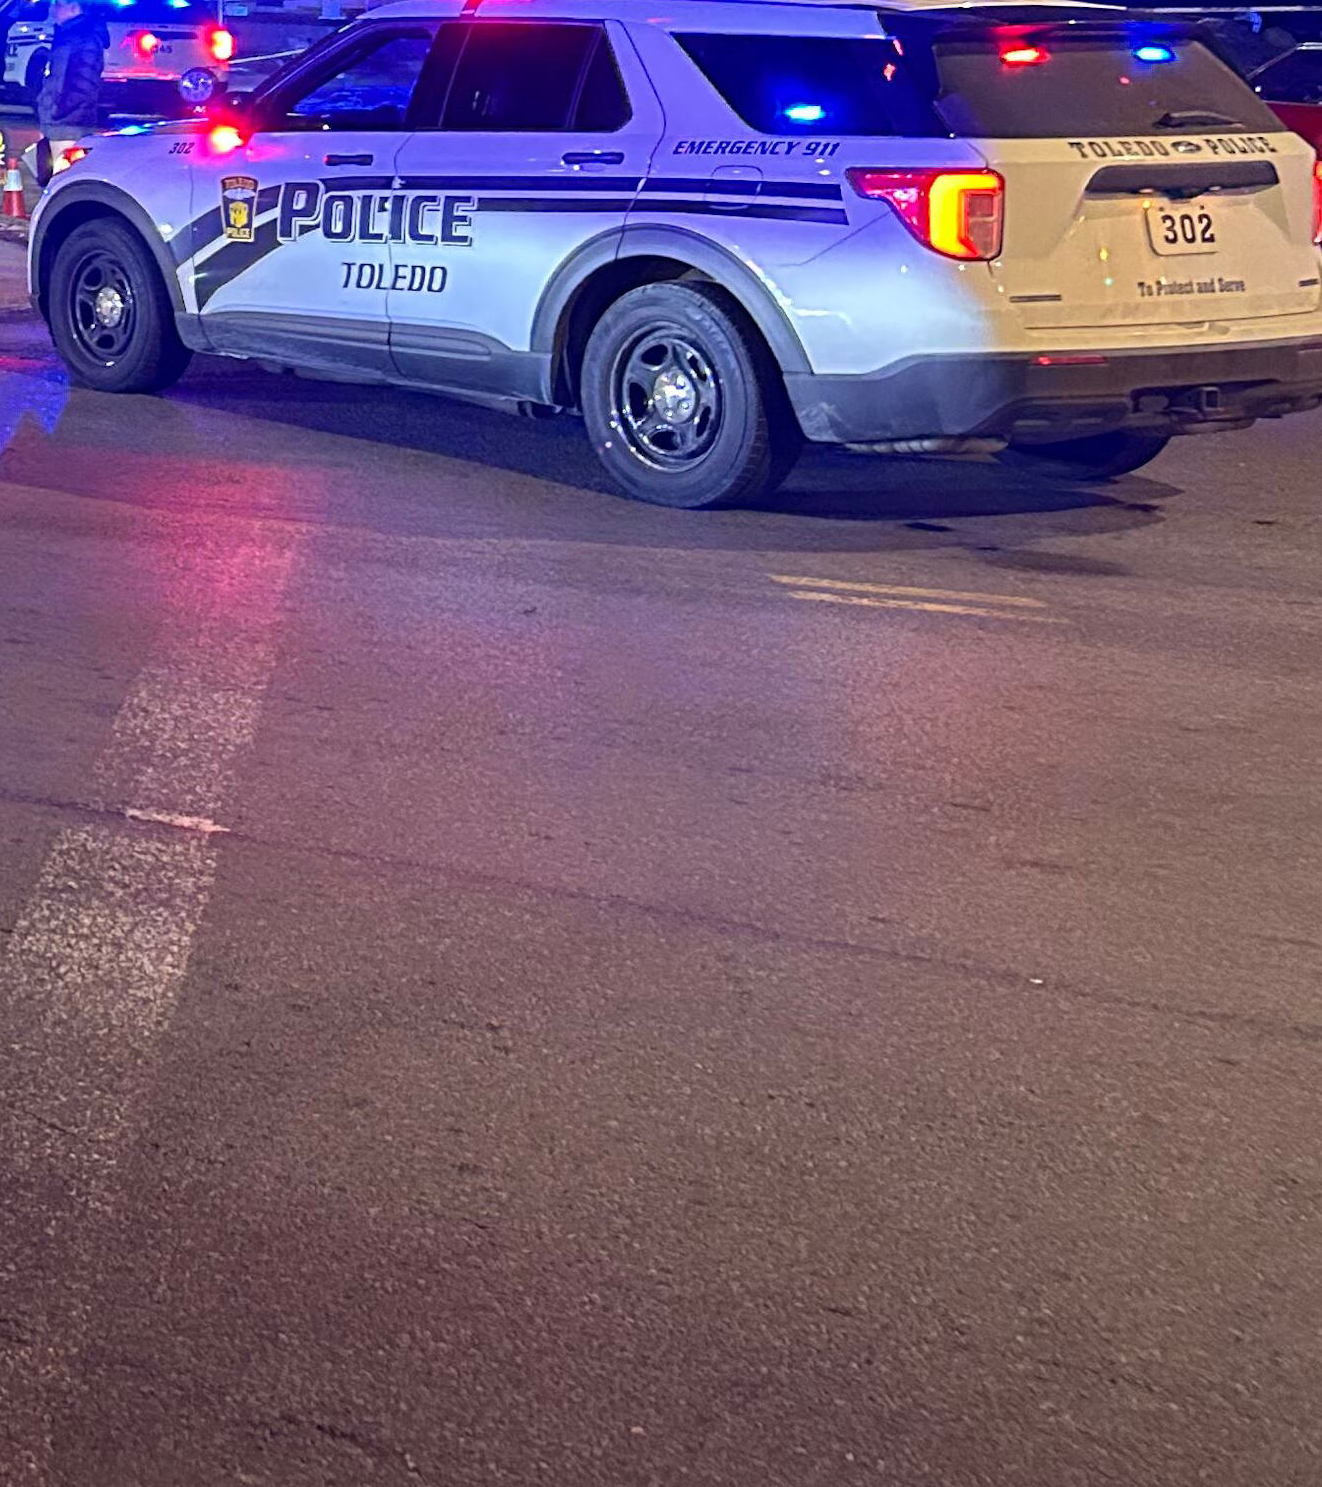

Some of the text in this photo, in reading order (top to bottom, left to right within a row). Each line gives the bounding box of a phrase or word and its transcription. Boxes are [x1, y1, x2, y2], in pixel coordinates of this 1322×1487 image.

[168, 142, 195, 154] 302
[672, 140, 840, 156] EMERGENCY 911
[1068, 136, 1277, 158] TOLEDO POLICE
[278, 181, 473, 246] POLICE
[1162, 212, 1216, 243] 302
[341, 262, 448, 293] TOLEDO
[1137, 277, 1246, 298] To Protect and Serve
